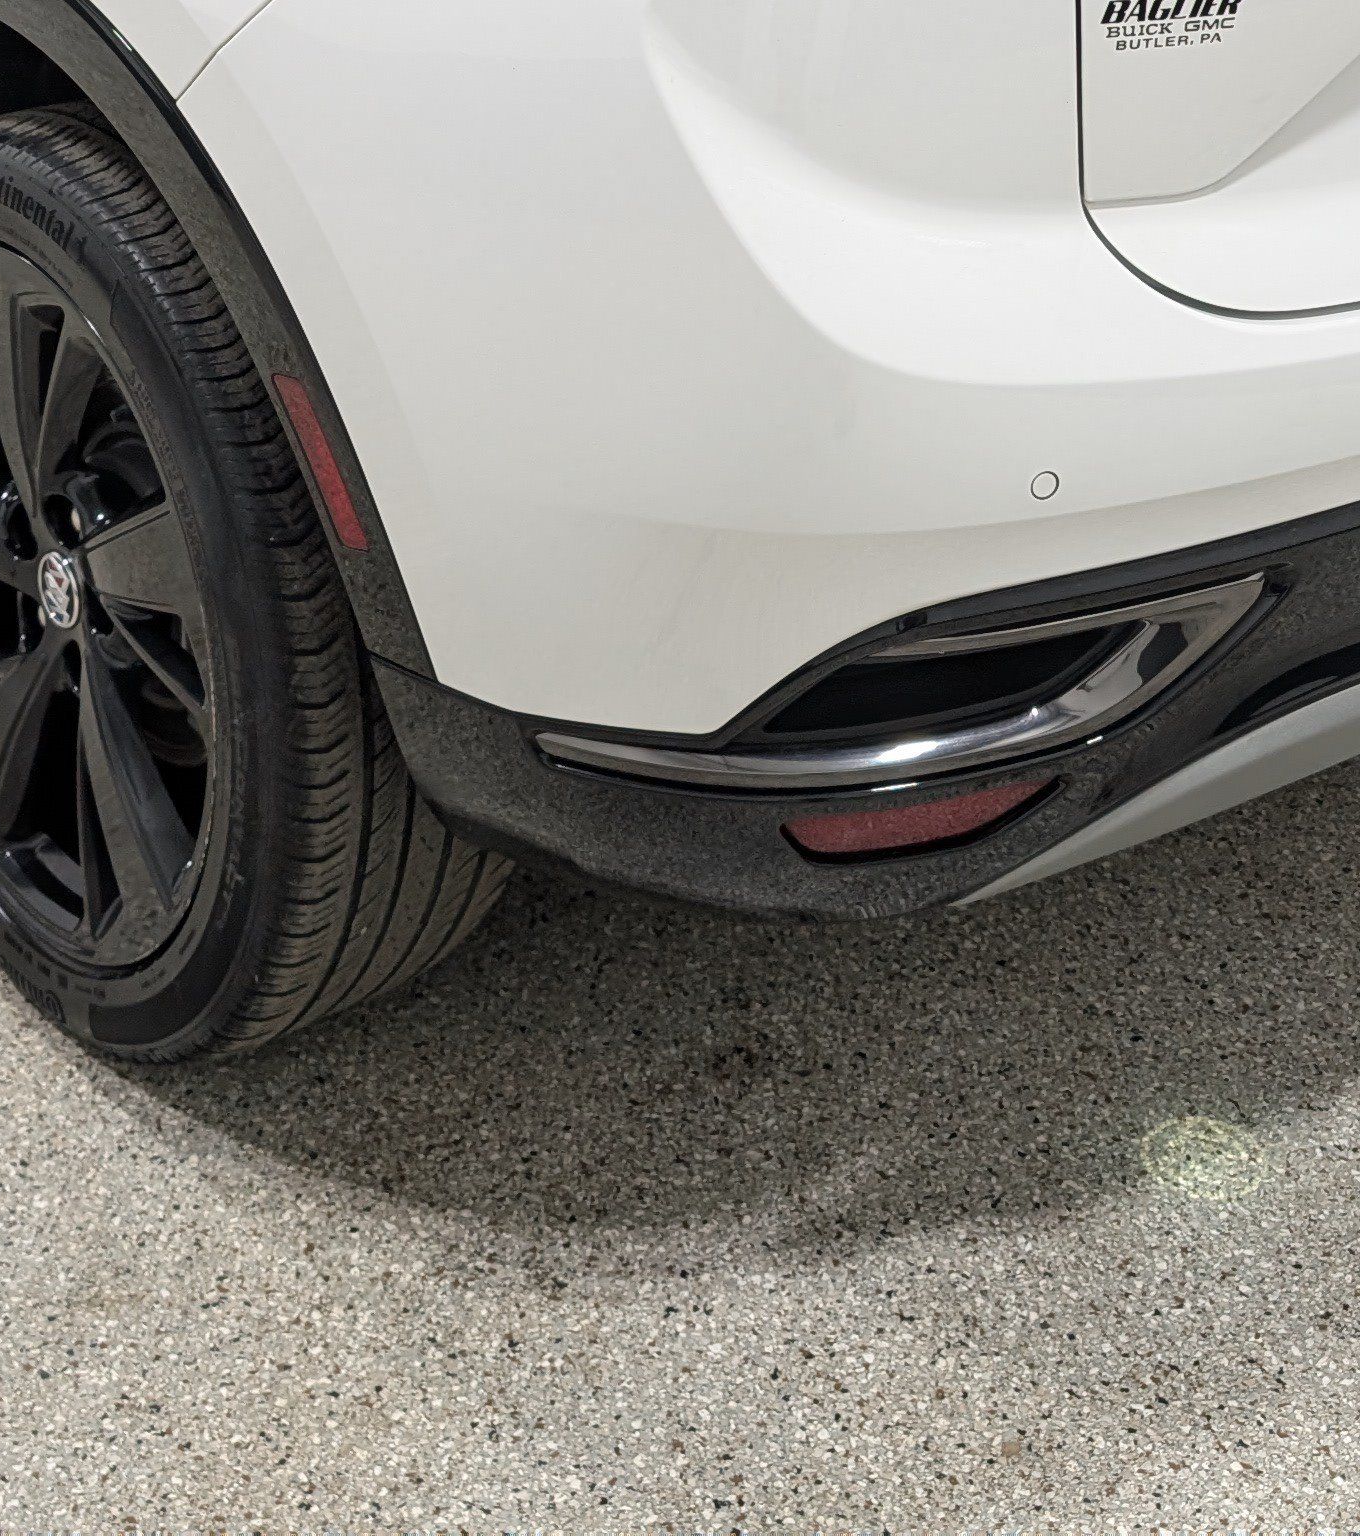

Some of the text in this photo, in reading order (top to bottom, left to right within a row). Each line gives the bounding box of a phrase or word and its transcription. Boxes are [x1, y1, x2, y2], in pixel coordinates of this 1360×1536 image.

[1105, 17, 1236, 39] BUICK GMC
[1115, 32, 1222, 51] BUTLER, PA
